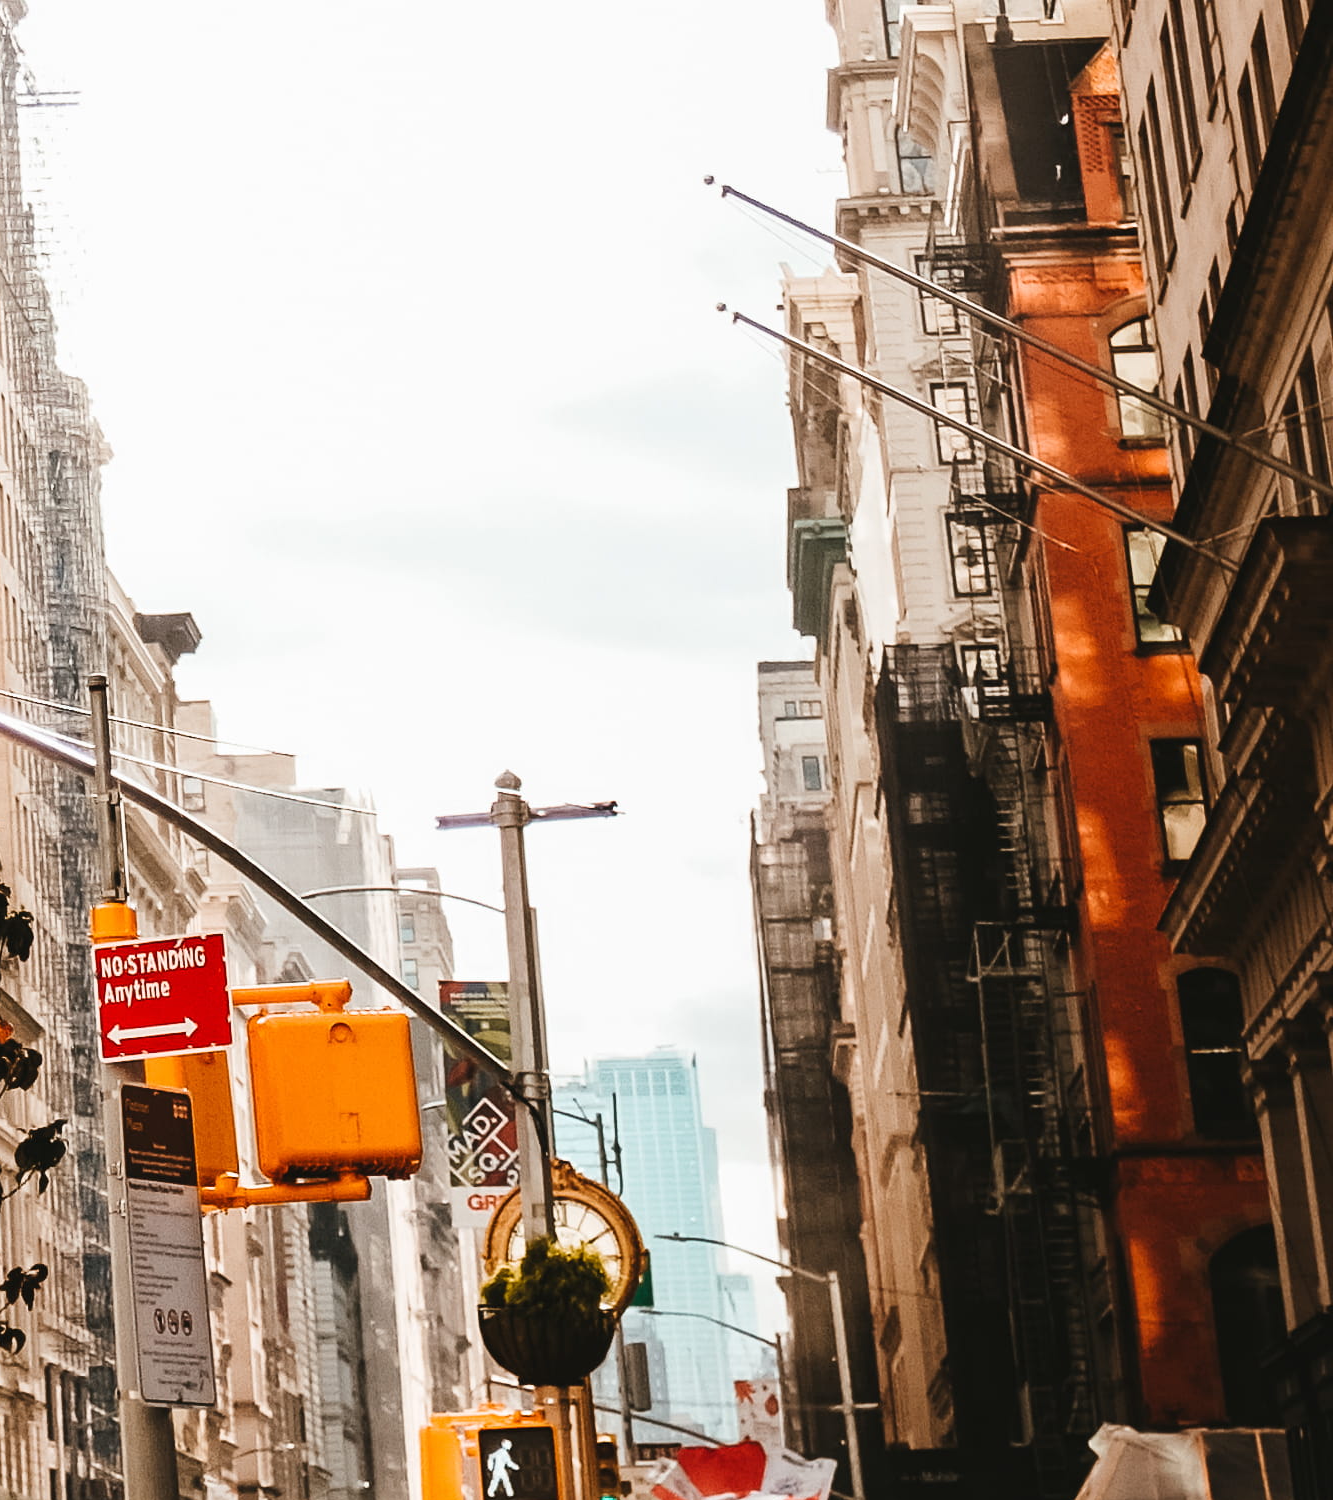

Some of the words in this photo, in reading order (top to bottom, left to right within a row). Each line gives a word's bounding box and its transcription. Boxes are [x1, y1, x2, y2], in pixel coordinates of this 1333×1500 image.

[100, 955, 123, 978] NO
[126, 945, 206, 975] STANDING
[104, 978, 170, 1008] Anytime
[448, 1114, 499, 1164] MAD.
